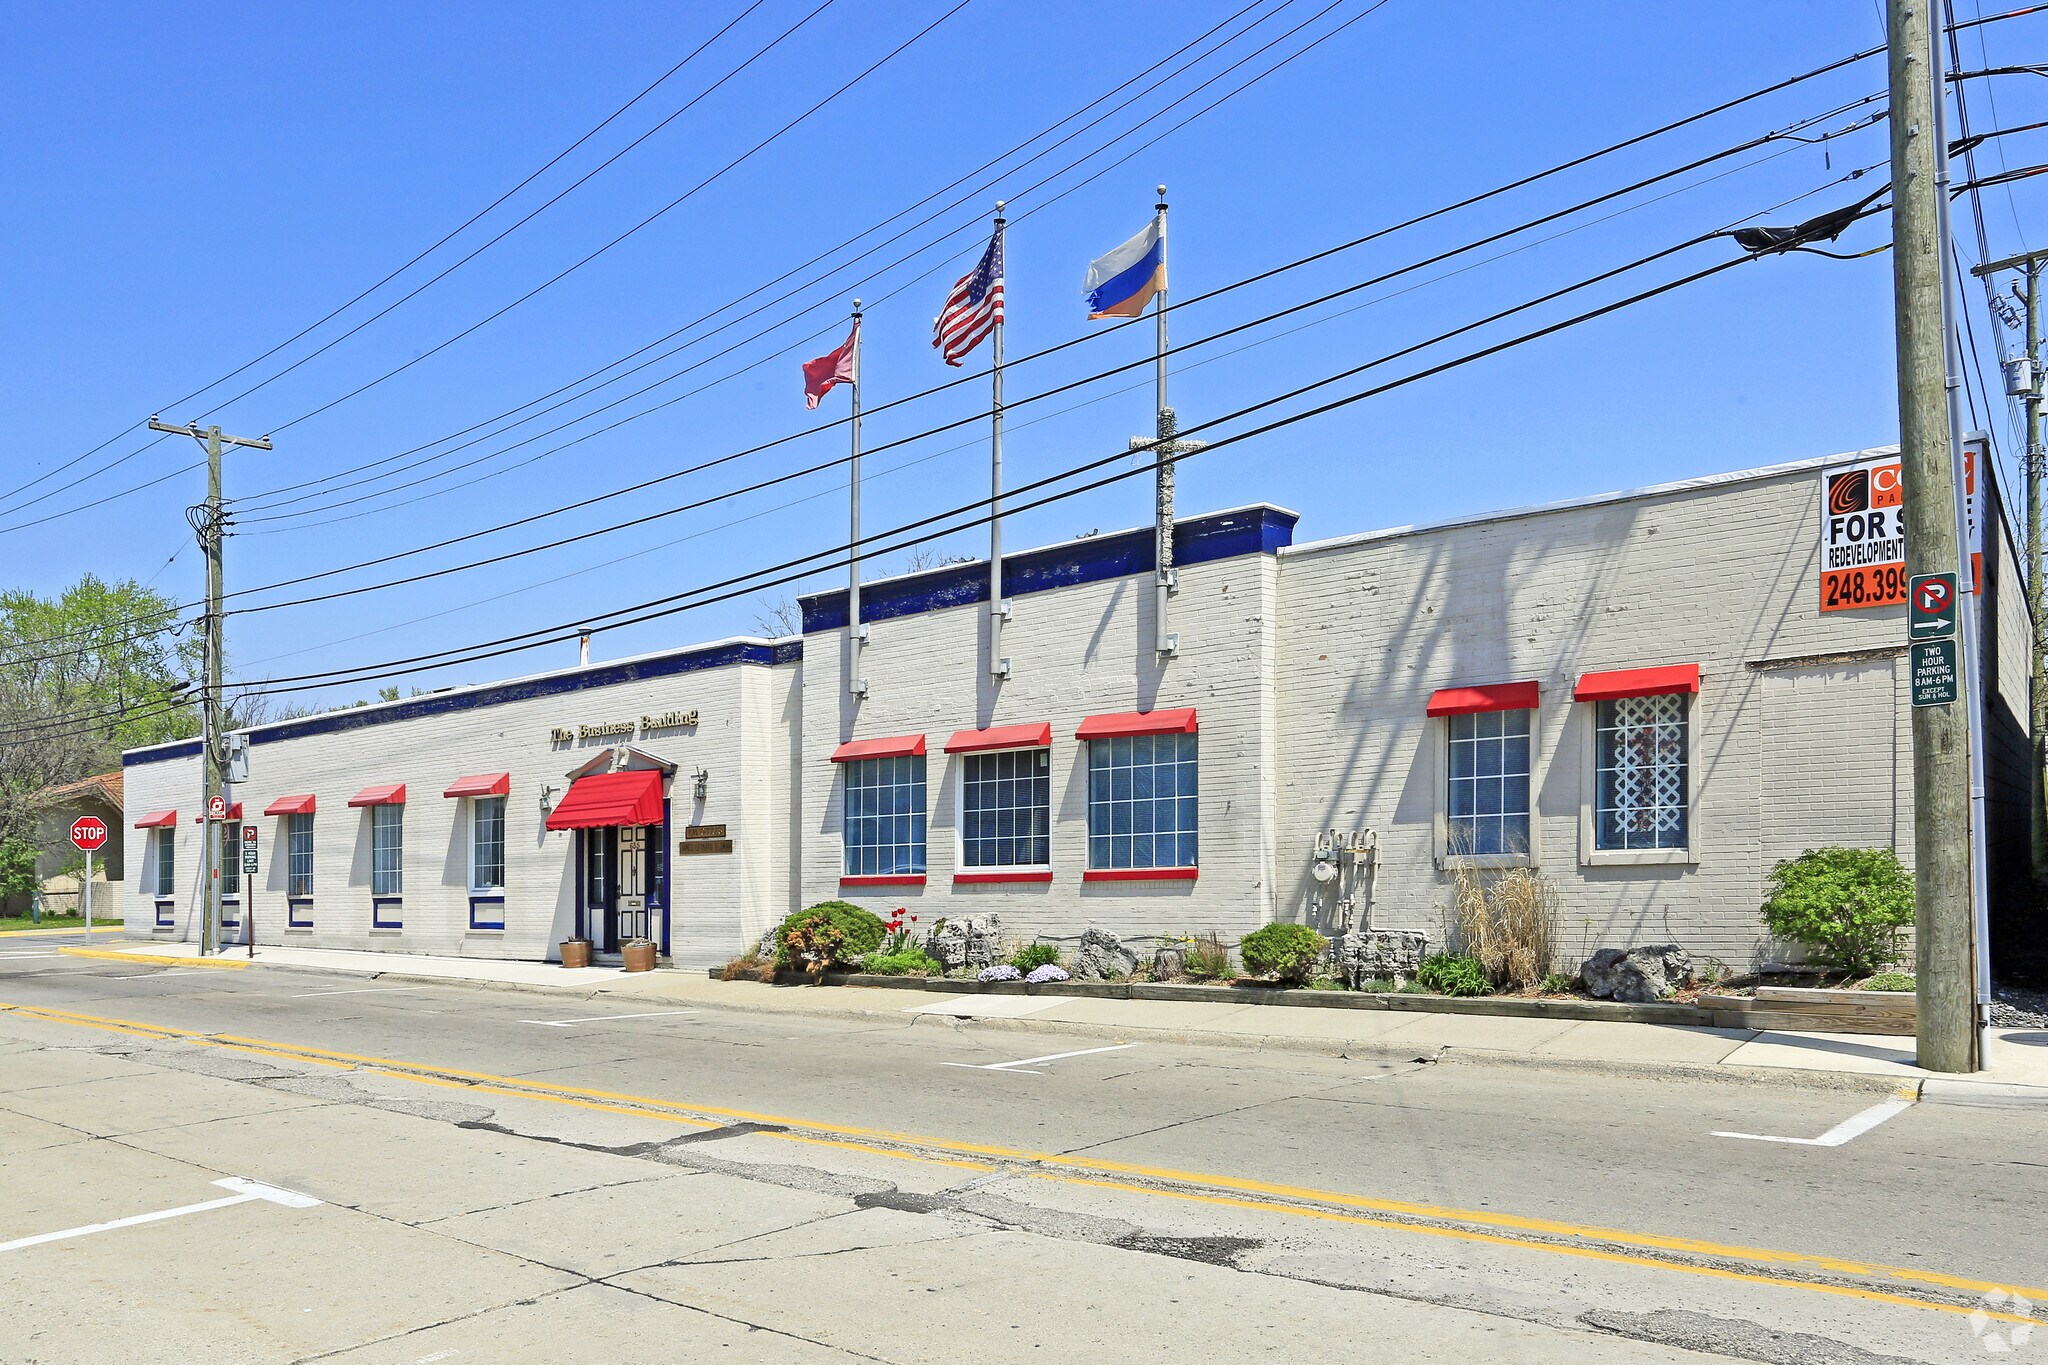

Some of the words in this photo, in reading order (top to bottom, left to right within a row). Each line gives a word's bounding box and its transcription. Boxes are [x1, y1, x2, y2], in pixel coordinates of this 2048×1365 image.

[1831, 512, 1886, 545] FOR
[1829, 538, 1904, 568] REDEVELOPMENT
[1924, 647, 1941, 656] TWO
[1922, 656, 1944, 666] HOUR
[1917, 665, 1950, 676] PARKING
[1922, 686, 1945, 694] EXCEPT
[550, 727, 573, 742] The
[578, 722, 635, 739] Business
[640, 708, 699, 730] Building
[73, 826, 105, 840] STOP
